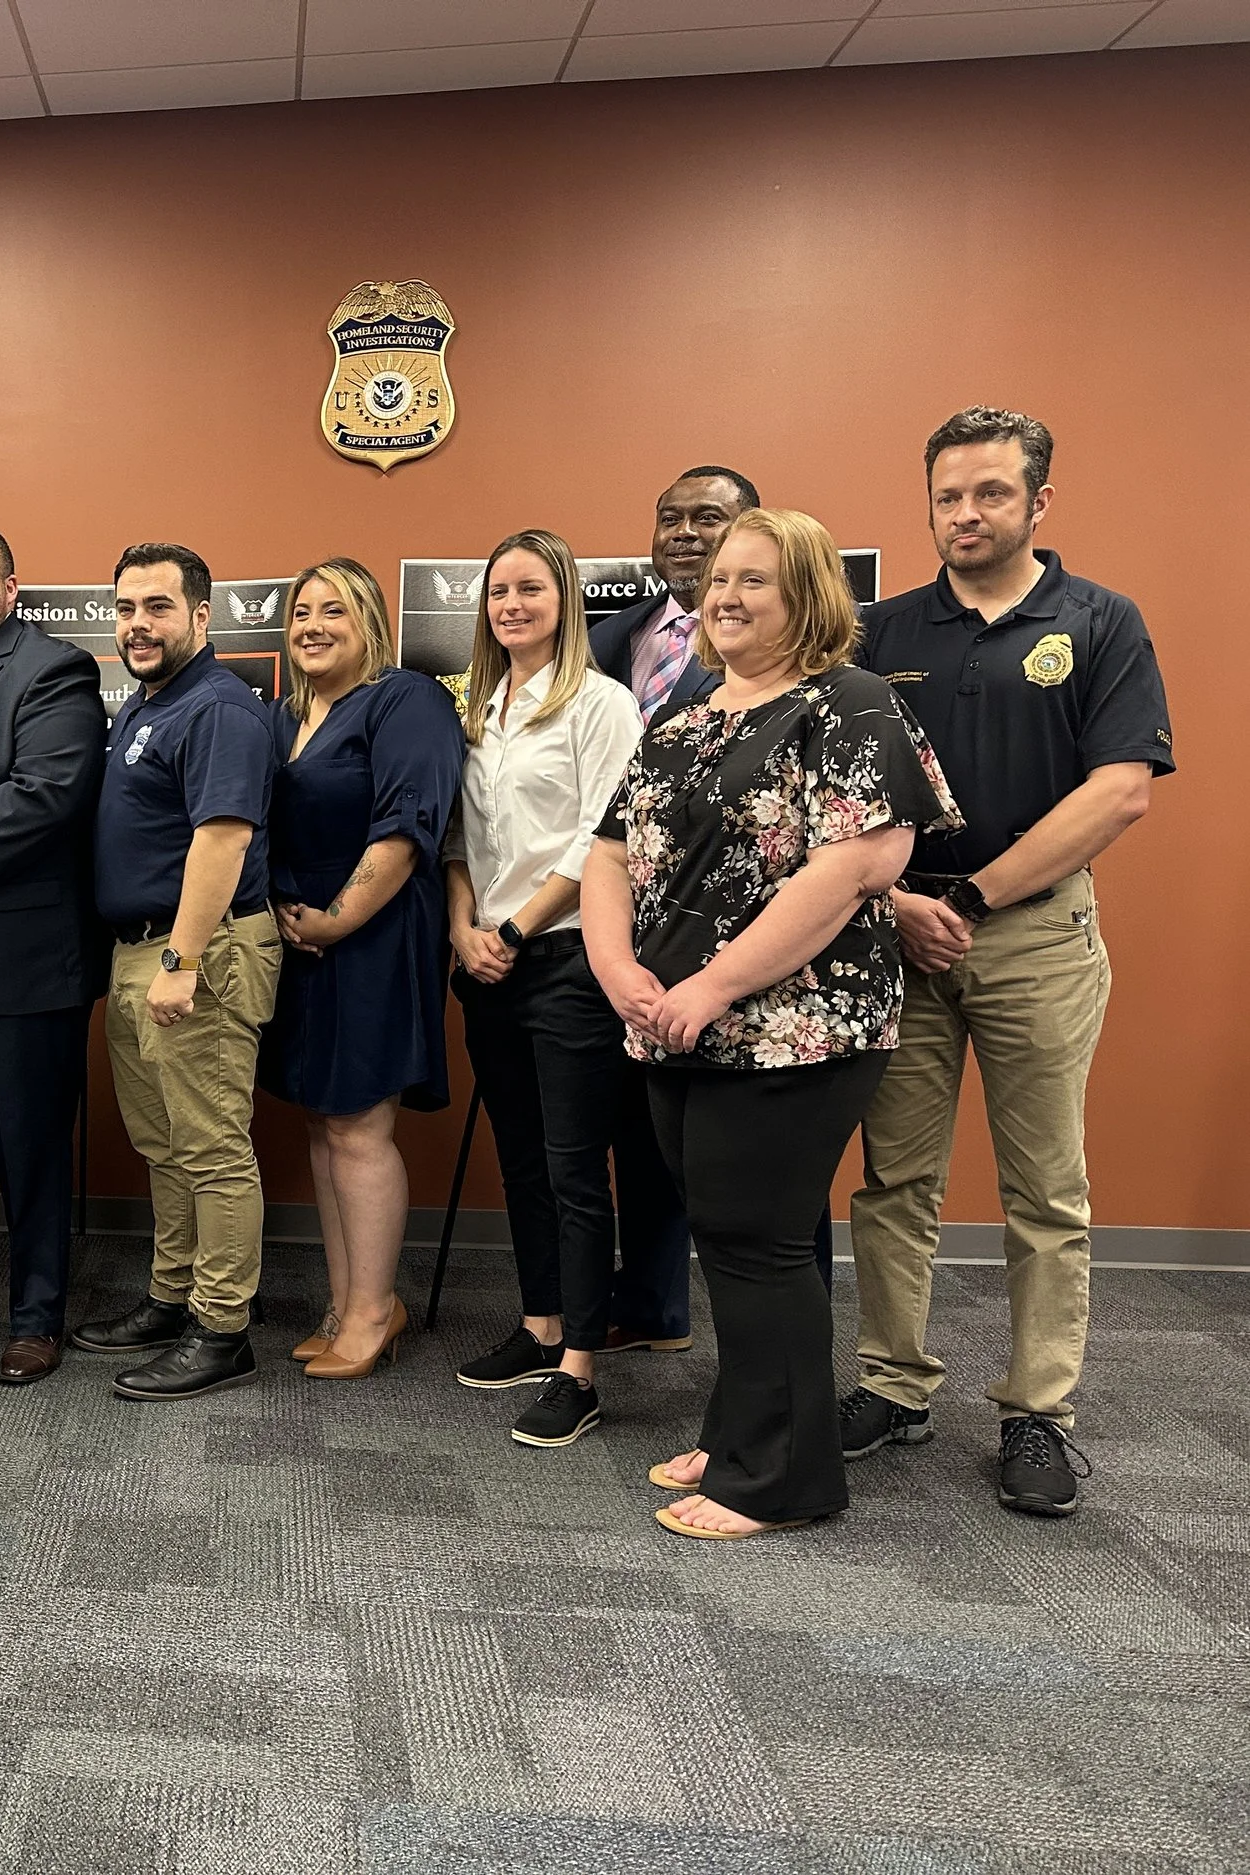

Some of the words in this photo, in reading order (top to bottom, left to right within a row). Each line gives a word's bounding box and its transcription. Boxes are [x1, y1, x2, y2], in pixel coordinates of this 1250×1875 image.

[337, 324, 395, 341] HOMELAND
[396, 324, 446, 339] SECURITY
[345, 335, 436, 349] INVESTIGATIONS
[335, 391, 350, 410] U
[426, 389, 439, 408] S
[345, 435, 388, 446] SPECIAL
[390, 434, 426, 446] AGENT
[16, 601, 78, 621] ission
[84, 600, 117, 621] Sta
